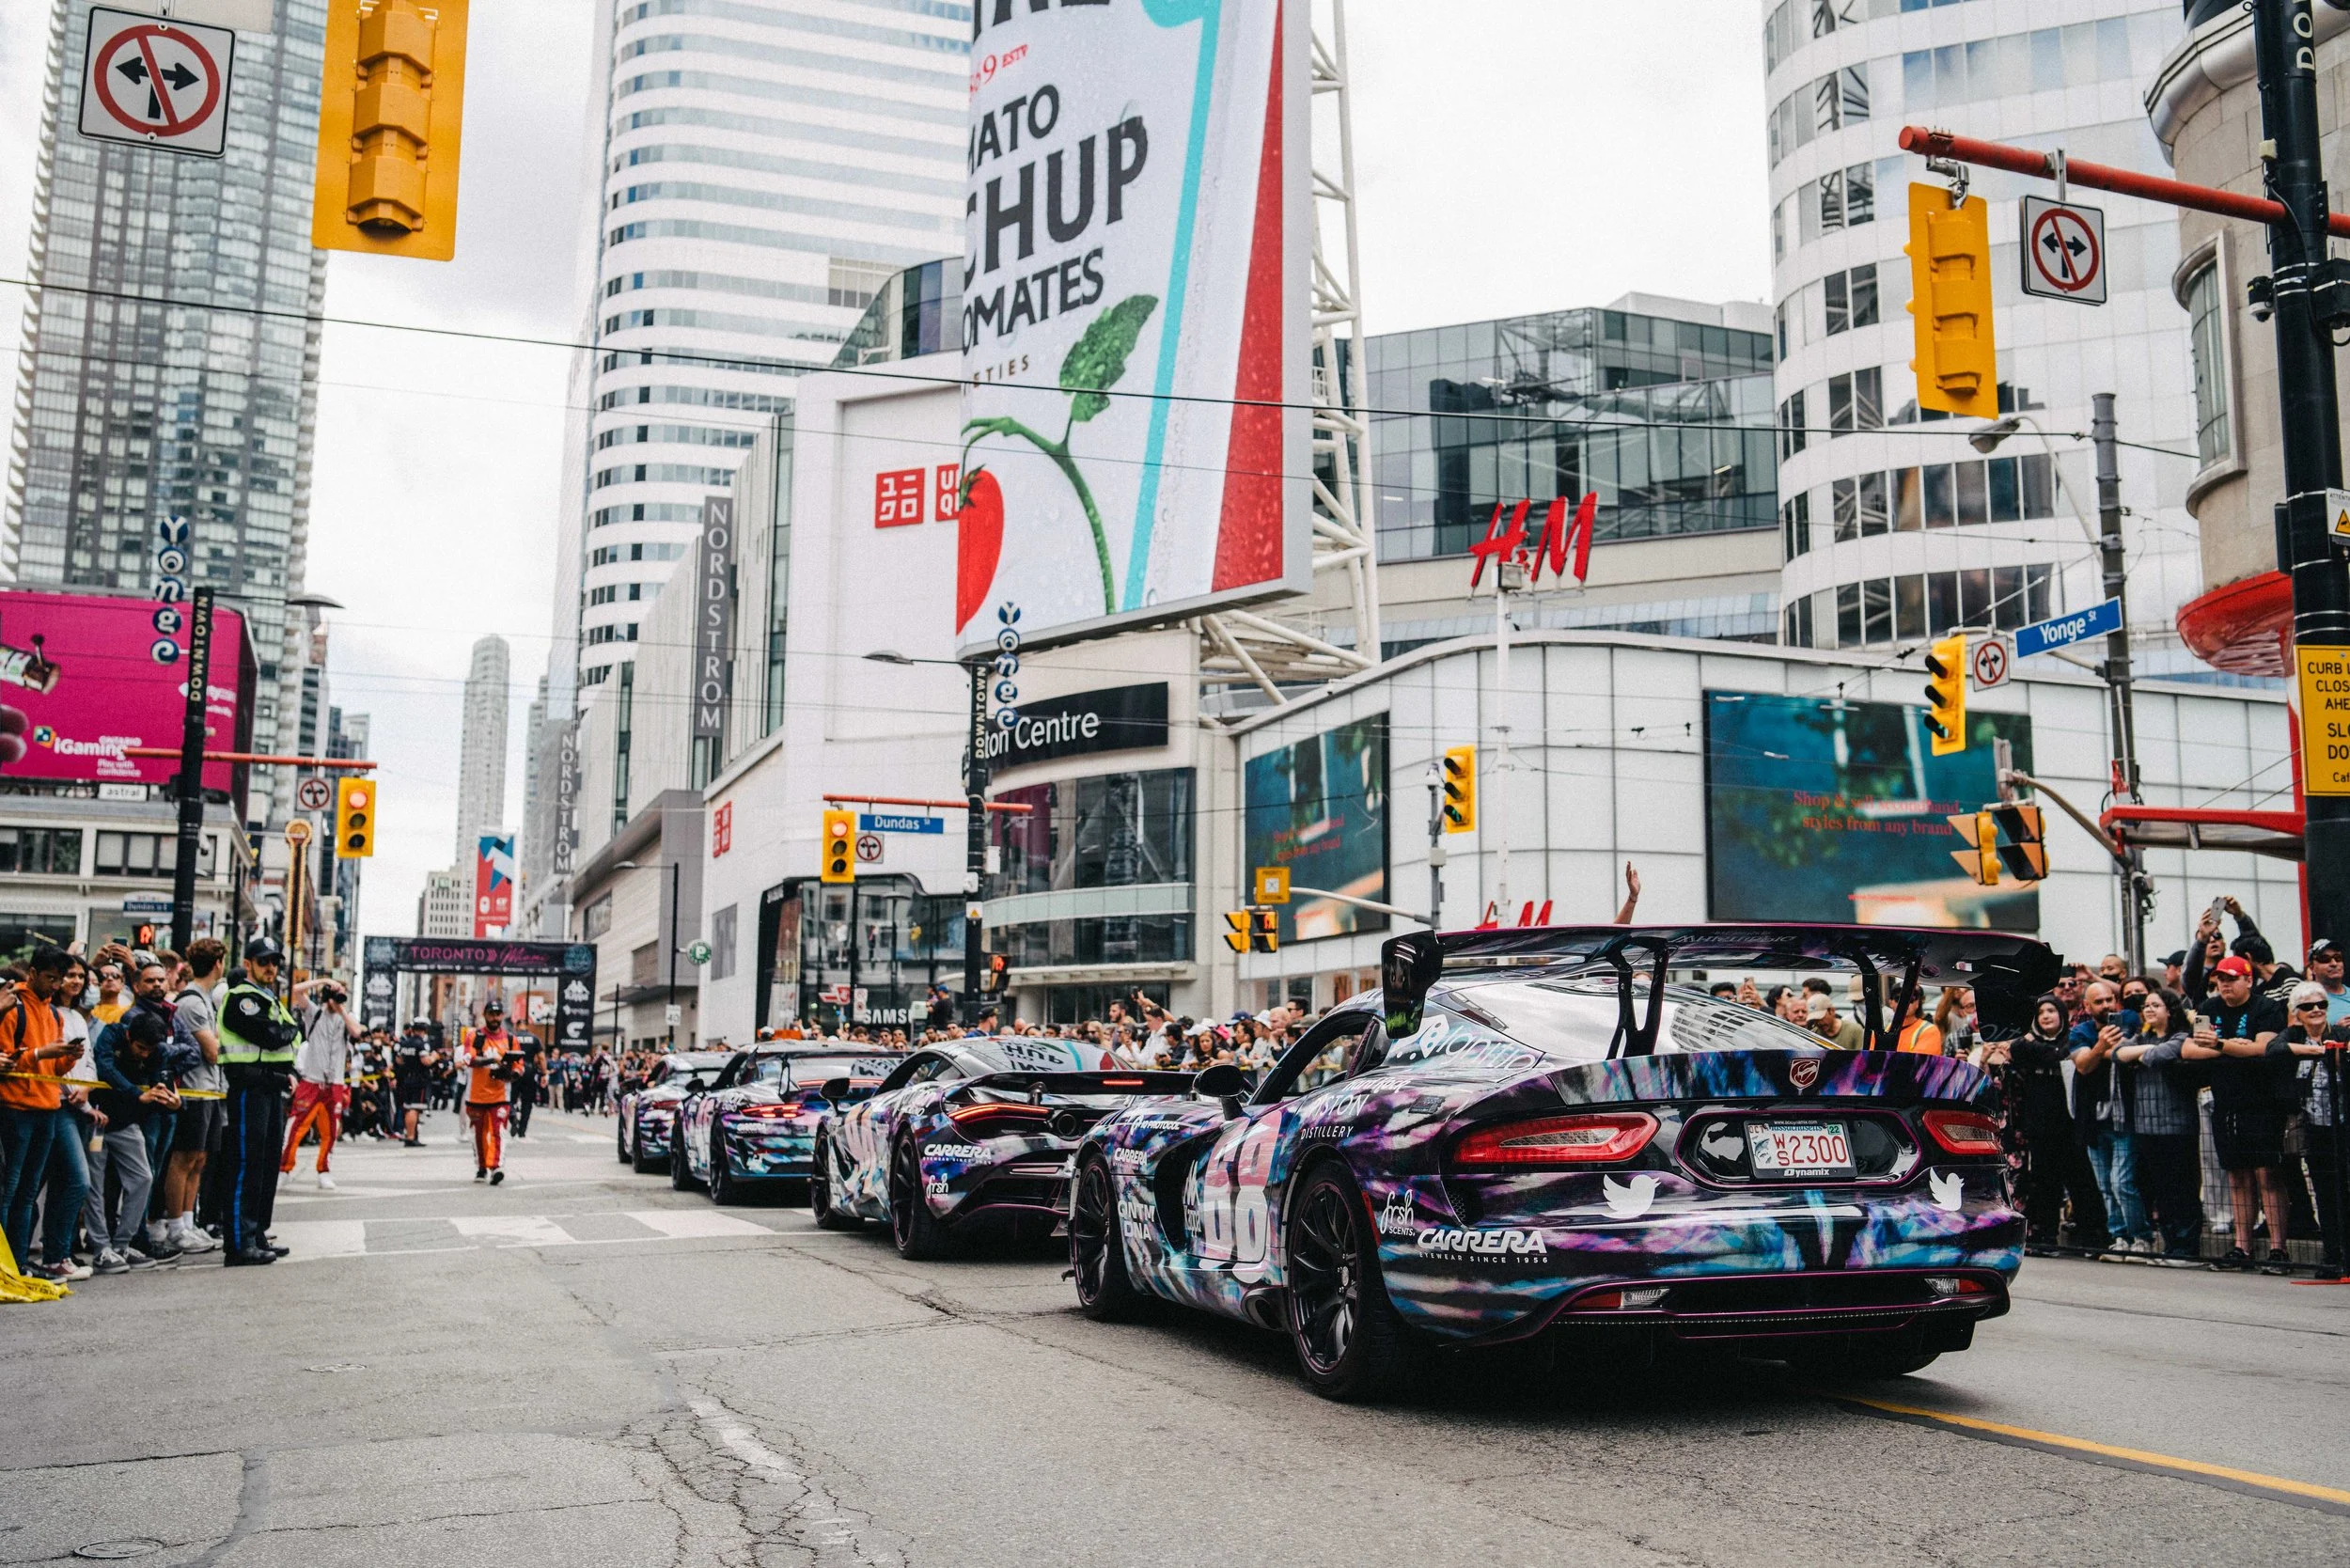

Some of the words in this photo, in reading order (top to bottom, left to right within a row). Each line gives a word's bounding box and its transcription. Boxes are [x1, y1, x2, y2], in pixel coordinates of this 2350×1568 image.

[2293, 0, 2315, 71] DO
[150, 515, 188, 666] Yonge
[700, 503, 728, 729] NORDSTROM
[2039, 617, 2086, 645] Yonge
[2088, 610, 2097, 622] St
[190, 595, 210, 702] DOWNTOWN
[995, 602, 1021, 730] Yonge
[2308, 661, 2342, 675] CURB
[975, 666, 986, 760] DOWNTOWN
[1015, 711, 1101, 750] Centre
[2327, 744, 2350, 760] DO
[556, 734, 574, 871] NORDSTROM
[1794, 791, 1830, 809] Shop
[874, 815, 920, 830] Dundas
[1802, 814, 1843, 832] styles
[1846, 816, 1880, 832] from
[1885, 821, 1908, 837] any
[1912, 818, 1952, 836] brand
[411, 946, 484, 962] TORONTO
[1301, 1125, 1354, 1139] DISTILLERY
[924, 1143, 992, 1160] CARRERA
[1114, 1147, 1148, 1167] CARRERA
[1789, 1135, 1847, 1164] 2300
[1783, 1168, 1830, 1178] Dynamix
[1118, 1200, 1155, 1222] QNTM
[1380, 1188, 1414, 1234] frsh
[1124, 1220, 1152, 1241] DNA
[1417, 1228, 1547, 1254] CARRERA
[1418, 1251, 1463, 1262] EYEWEAR
